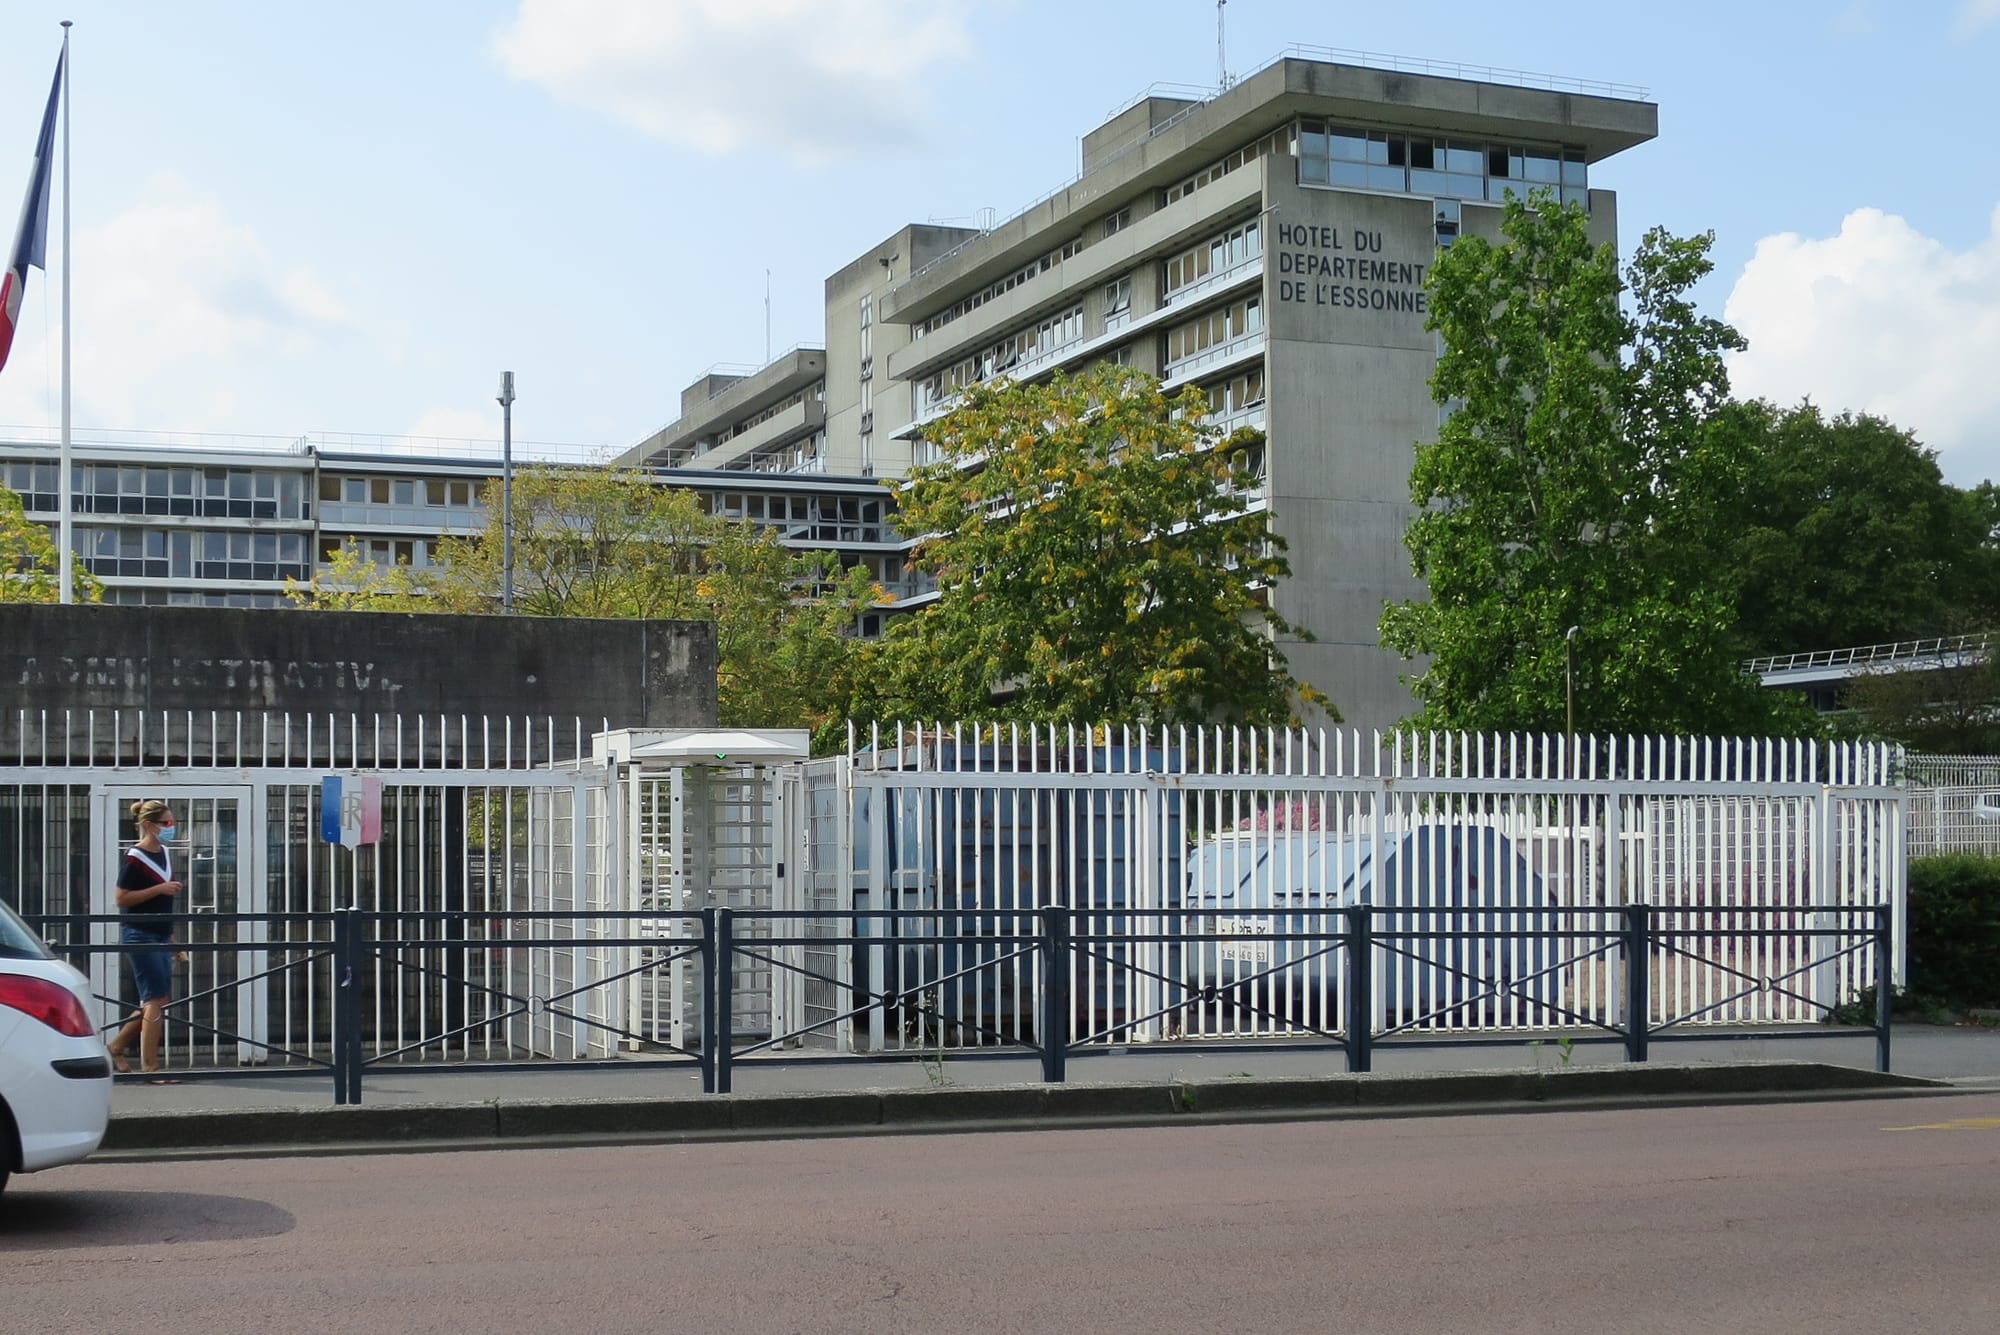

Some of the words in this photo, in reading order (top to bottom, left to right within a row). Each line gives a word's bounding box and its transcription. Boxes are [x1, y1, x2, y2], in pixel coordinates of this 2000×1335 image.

[1279, 223, 1342, 249] HOTEL
[1355, 230, 1382, 253] DU
[1280, 252, 1424, 285] DEPARTEMENT
[1280, 280, 1306, 303] DE
[1316, 283, 1426, 313] L'ESSONNE
